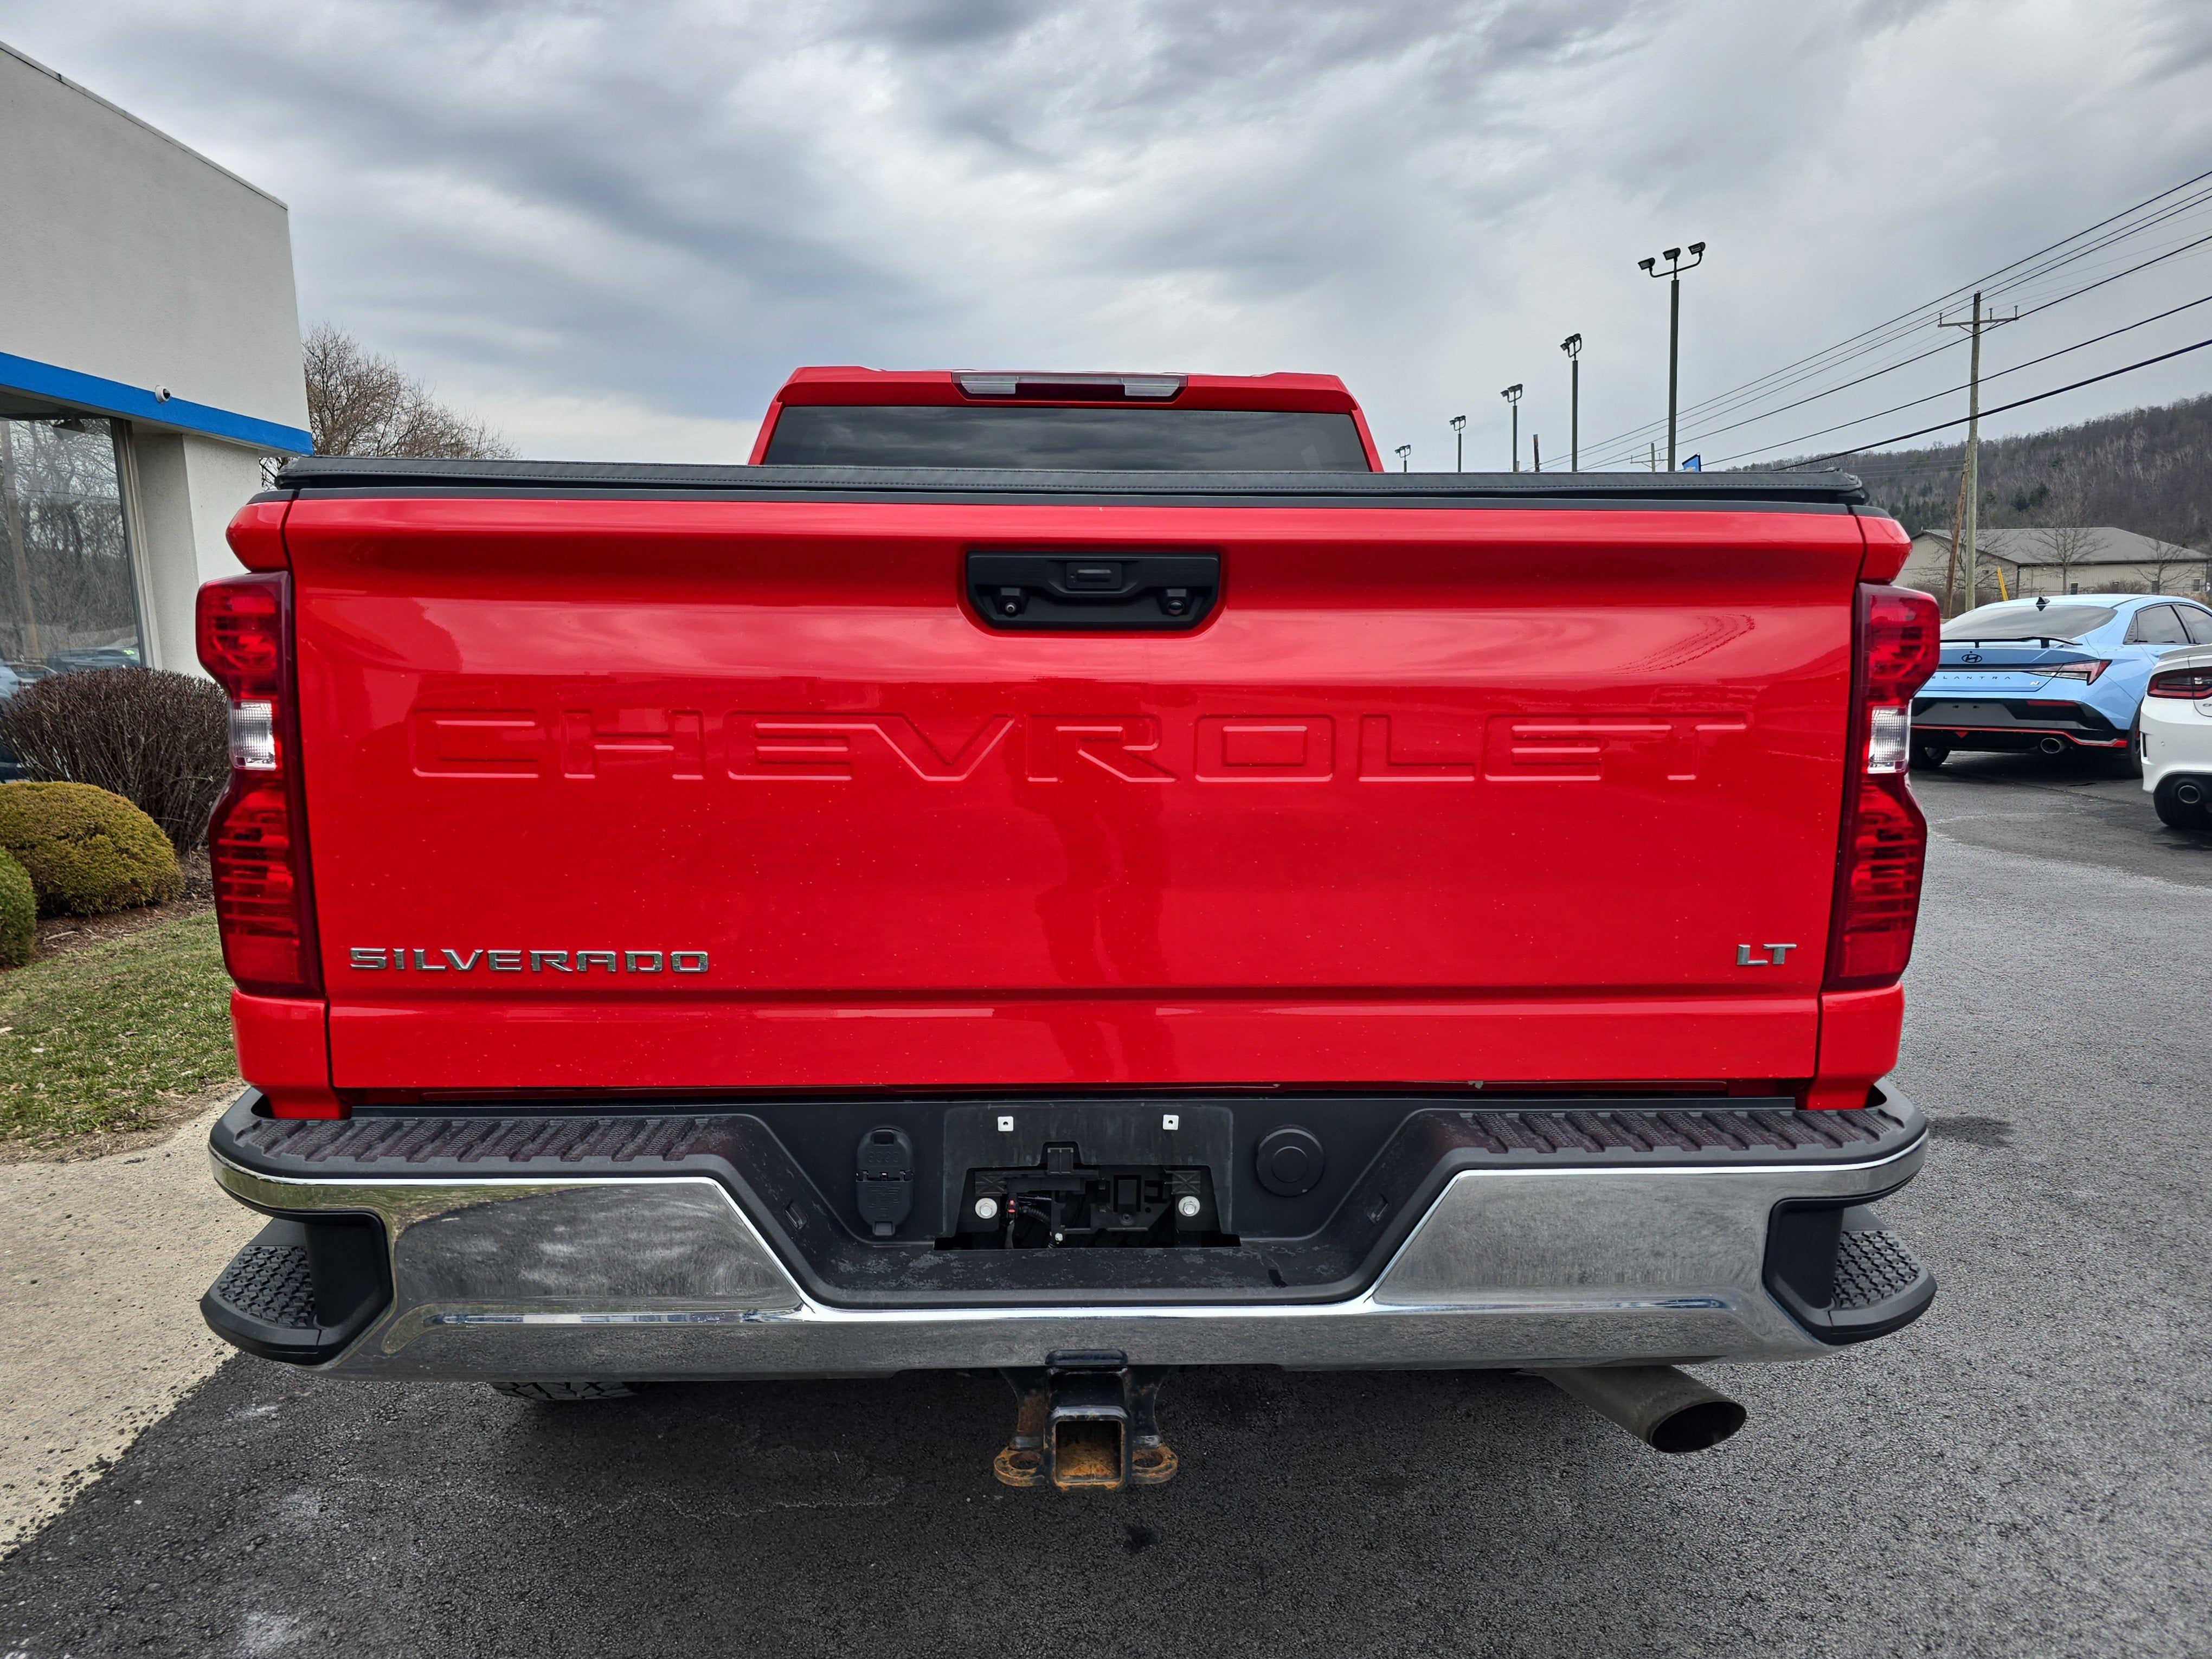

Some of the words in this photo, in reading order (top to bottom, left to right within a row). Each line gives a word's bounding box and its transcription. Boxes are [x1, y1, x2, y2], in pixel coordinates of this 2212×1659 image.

[410, 709, 1747, 782] CHEVROLET
[349, 947, 710, 972] SILVERADO
[1737, 943, 1797, 966] LT
